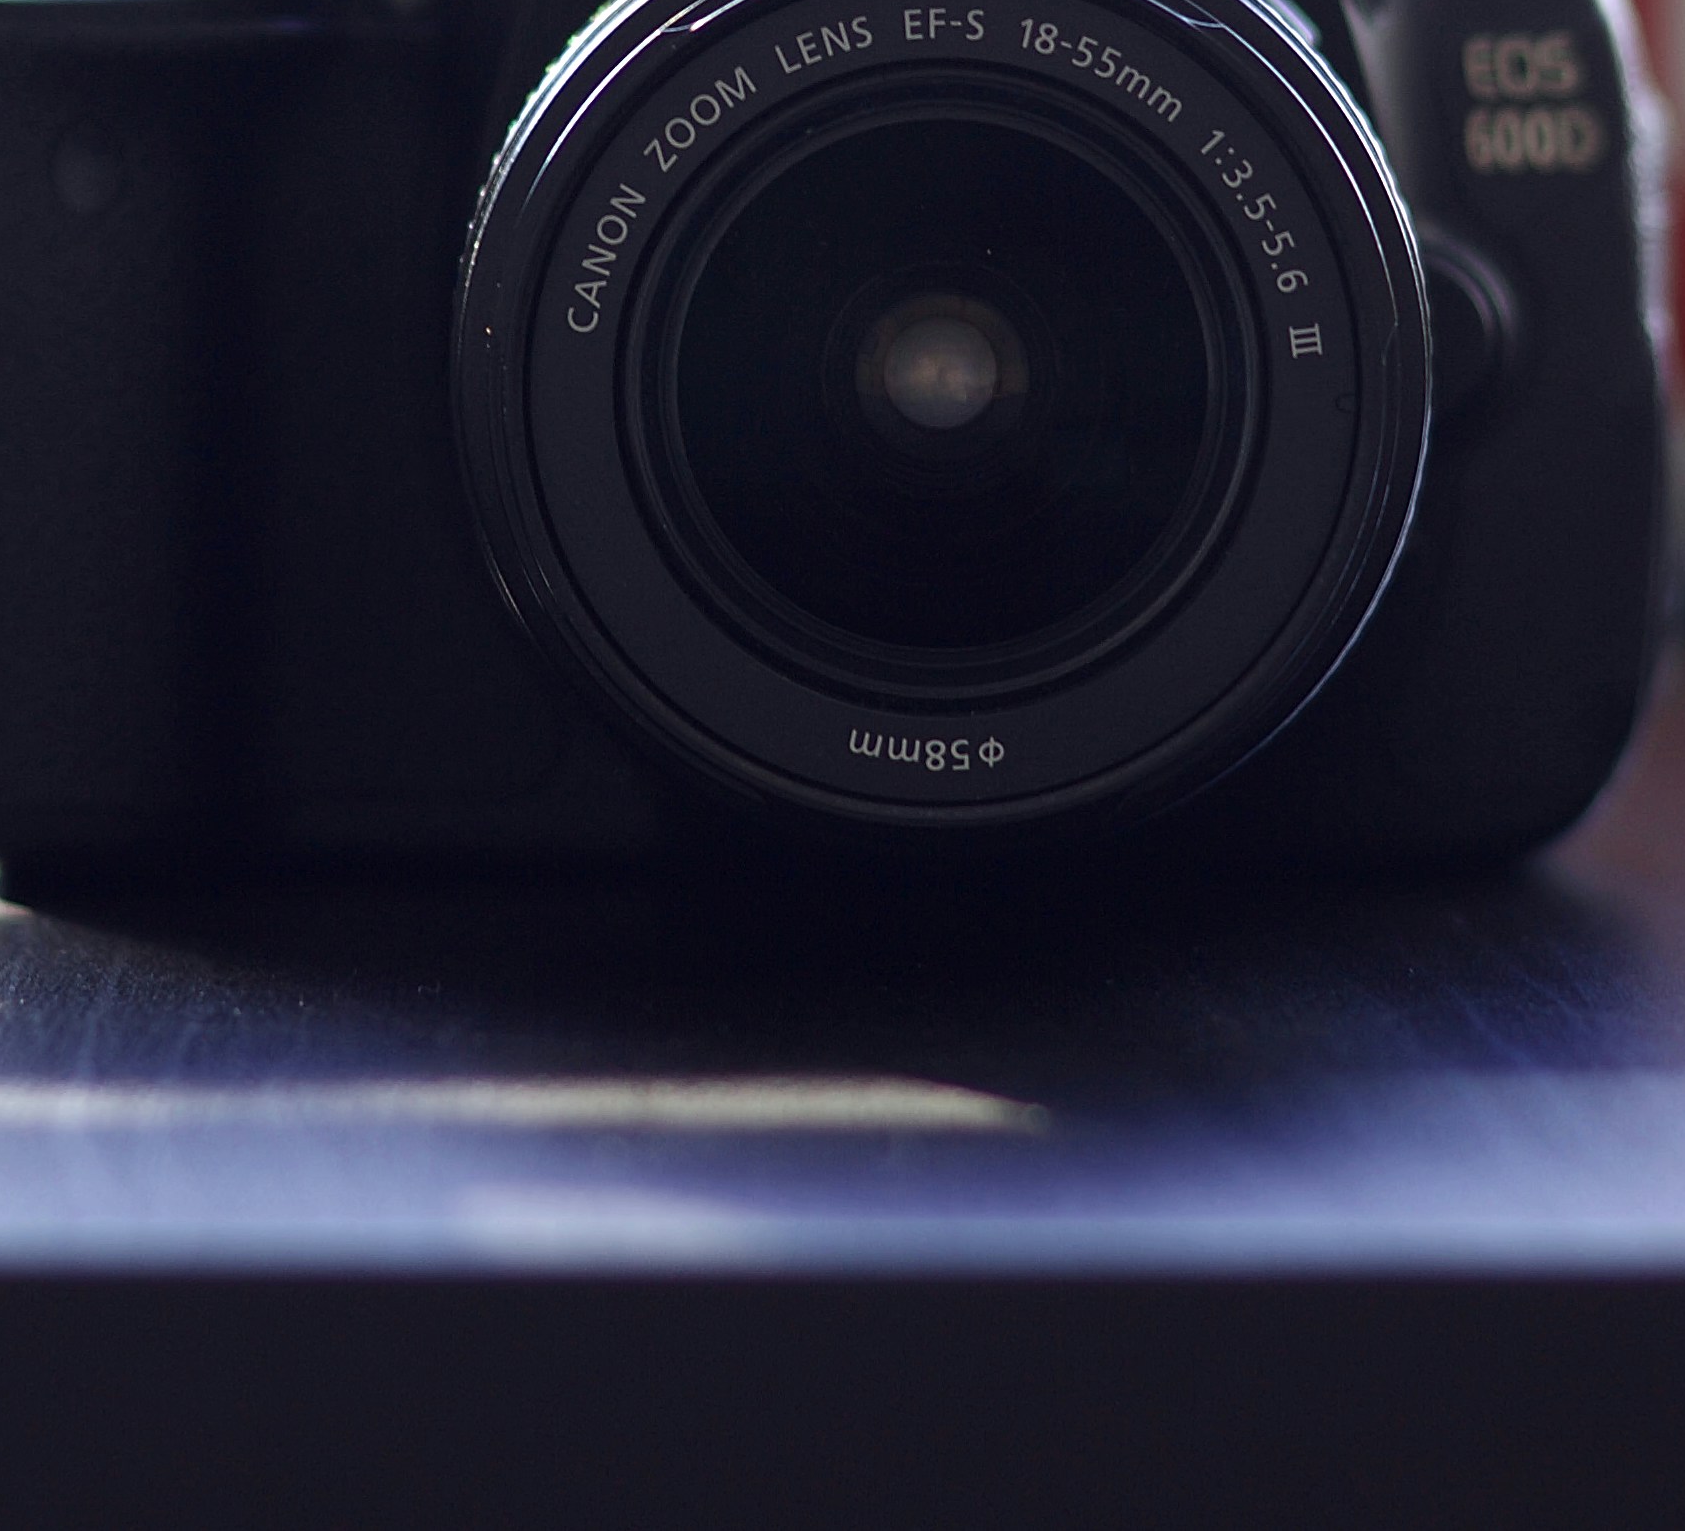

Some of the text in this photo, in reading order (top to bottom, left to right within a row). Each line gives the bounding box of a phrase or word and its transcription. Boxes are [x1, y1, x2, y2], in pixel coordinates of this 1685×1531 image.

[1462, 32, 1580, 98] EOS
[567, 183, 646, 333] CANON
[643, 66, 757, 172] ZOOM
[774, 16, 873, 74] LENS
[903, 8, 985, 41] EF-S
[1020, 18, 1183, 122] 18-55mm
[1200, 130, 1309, 293] 1:3.5-5.6
[1463, 107, 1607, 168] 600D
